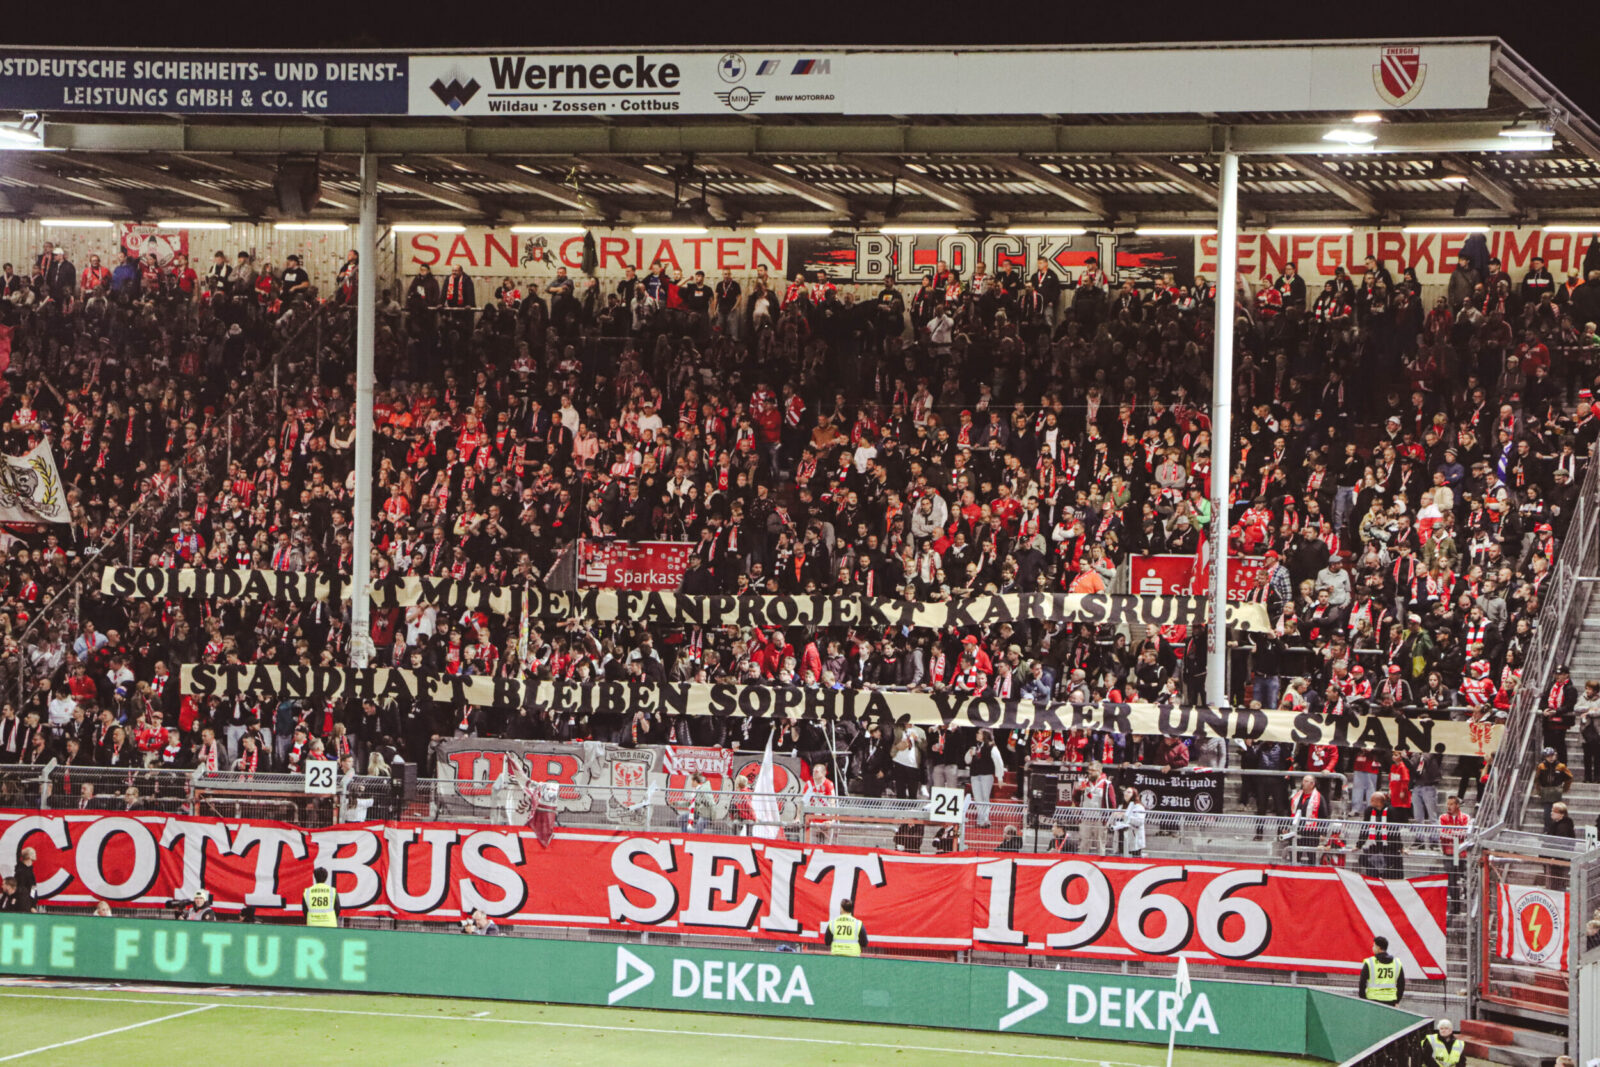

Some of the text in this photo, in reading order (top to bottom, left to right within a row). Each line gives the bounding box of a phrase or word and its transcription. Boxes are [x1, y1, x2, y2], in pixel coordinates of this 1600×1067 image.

[134, 60, 267, 80] SICHERHEITS-
[274, 63, 318, 80] UND
[326, 64, 403, 82] DIENST-
[490, 56, 681, 89] Wernecke
[63, 86, 328, 108] LEISTUNGS GMBH & CO. KG
[489, 99, 680, 112] Wildau Zossen Cottbus
[411, 232, 785, 271] SAN GRIATEN
[854, 233, 1073, 285] BLOCK
[614, 569, 684, 586] Sparkass
[110, 566, 404, 611] SOLIDARITT
[420, 575, 508, 616] MIT
[511, 585, 600, 620] DEM
[617, 590, 924, 629] FANPROJEKT
[190, 663, 1446, 754] STANDHAFT BLEIBEN SOPHIA, VOLKER UND STAN.
[673, 757, 725, 773] KEVIN
[309, 767, 332, 788] 23
[934, 793, 959, 816] 24
[0, 815, 1272, 960] COTTBUS SEIT 1966
[312, 896, 329, 907] 268
[837, 925, 852, 936] 270
[115, 931, 368, 981] FUTURE
[672, 958, 815, 1006] DEKRA
[1377, 967, 1393, 978] 275
[1066, 983, 1221, 1035] DEKRA
